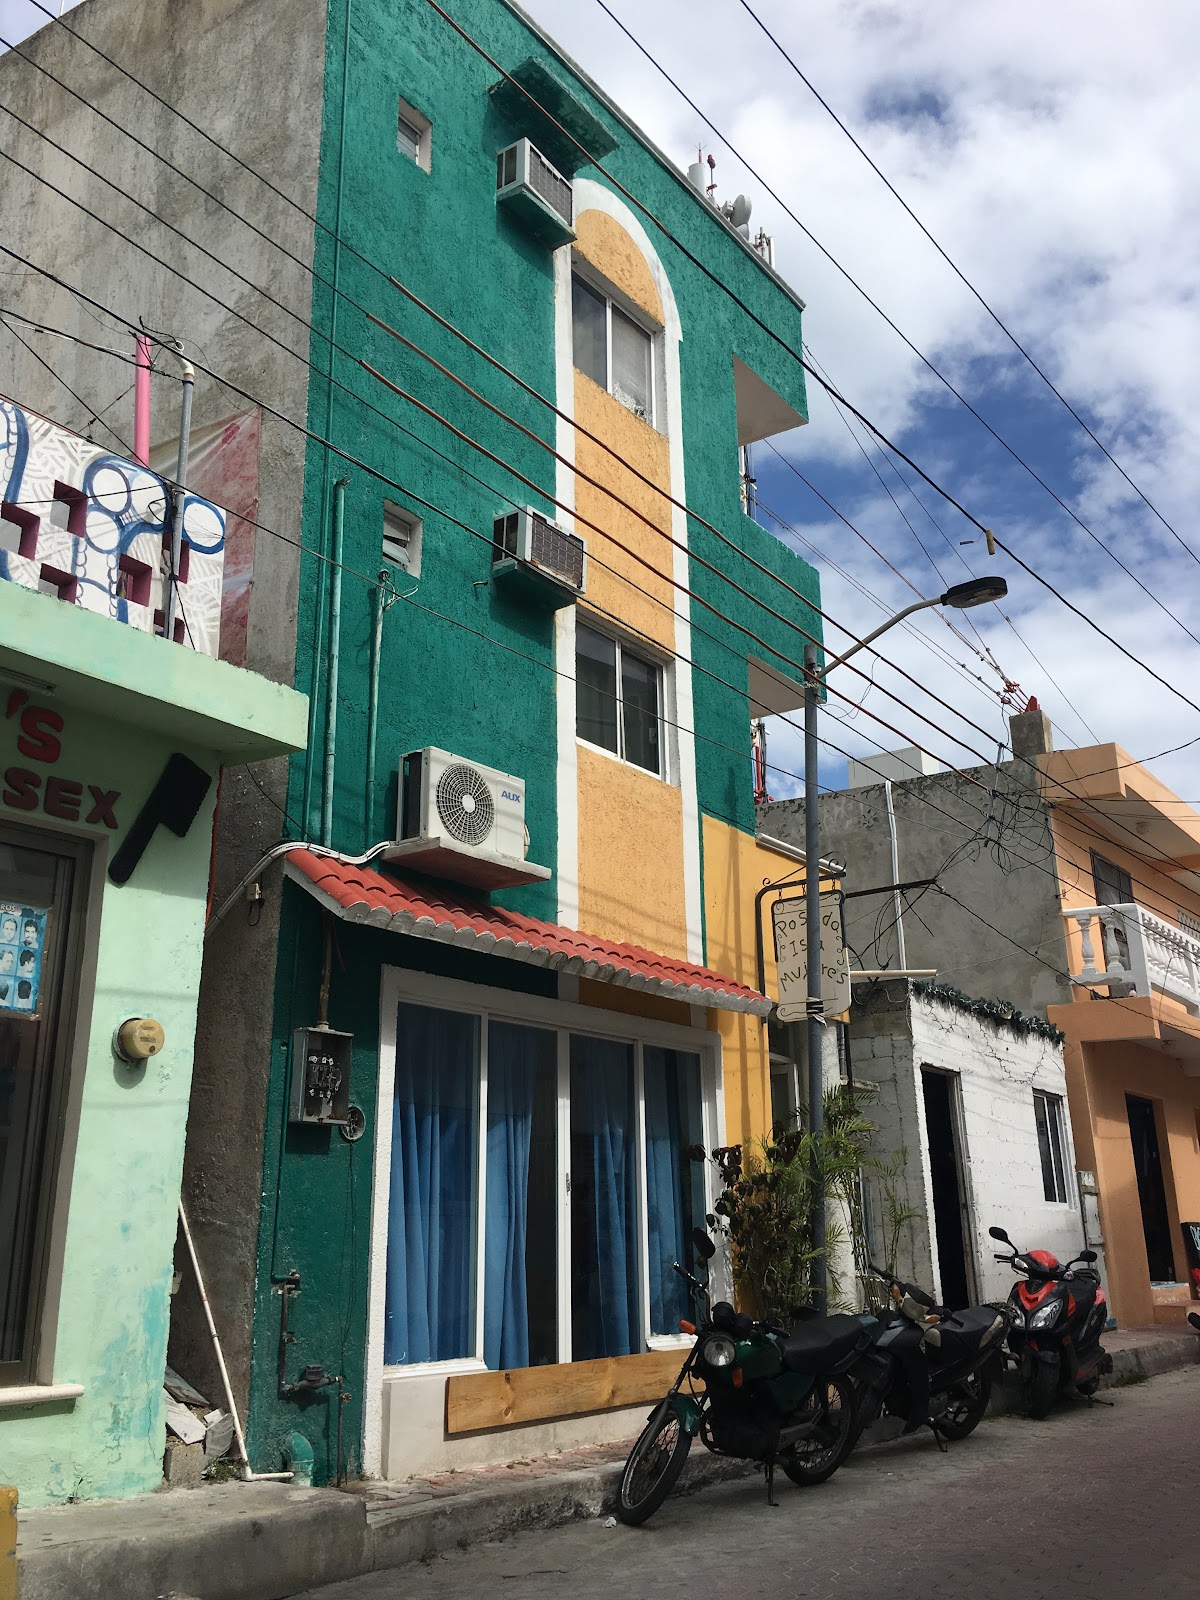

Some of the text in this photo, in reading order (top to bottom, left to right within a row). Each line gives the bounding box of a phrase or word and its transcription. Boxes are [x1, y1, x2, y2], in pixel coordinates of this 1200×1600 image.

[2, 766, 122, 830] SEX
[501, 790, 521, 803] AUX
[775, 911, 840, 938] Posda
[780, 961, 849, 992] Mujres
